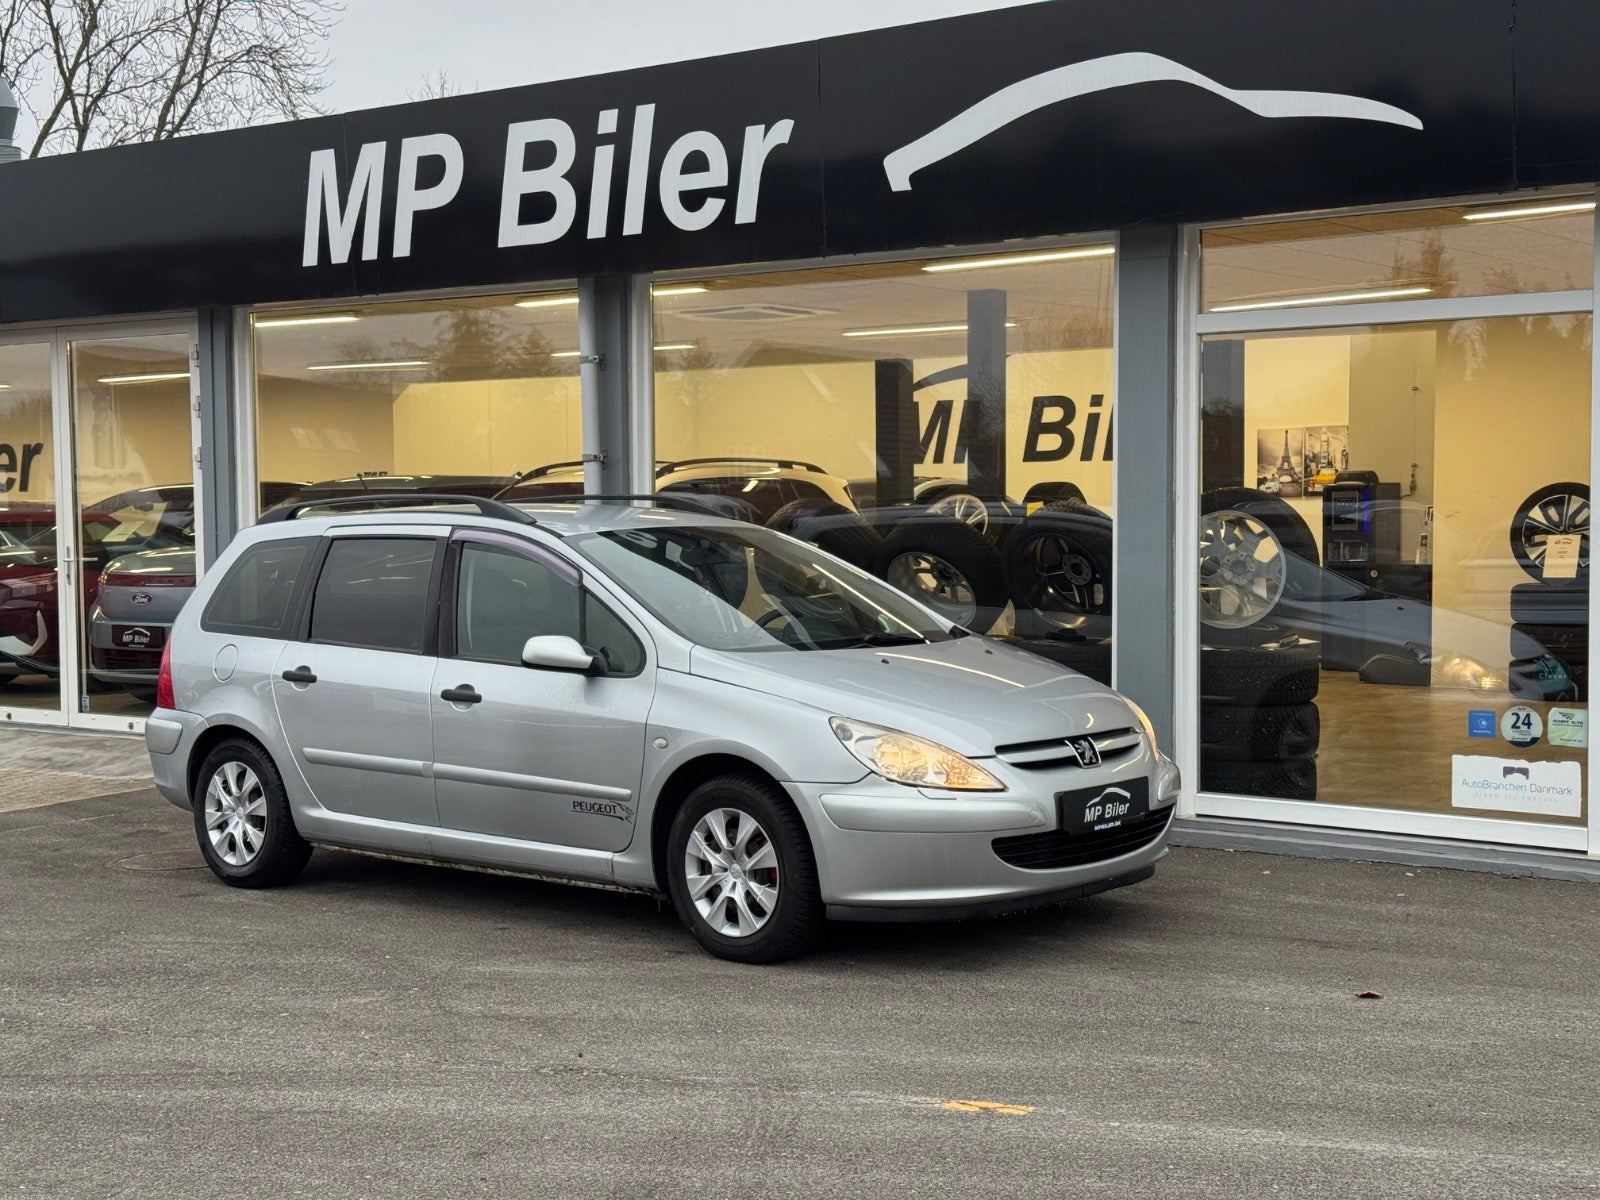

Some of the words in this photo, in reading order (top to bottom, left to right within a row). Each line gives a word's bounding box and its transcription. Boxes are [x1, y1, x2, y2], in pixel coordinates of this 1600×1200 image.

[302, 133, 464, 267] MP
[497, 103, 795, 248] Biler
[122, 634, 133, 643] MP
[134, 635, 150, 644] Biler
[1511, 712, 1532, 729] 24
[1461, 778, 1526, 793] AutoBranchen
[1529, 783, 1573, 796] Danmark
[572, 801, 617, 814] PEUGEOT
[1084, 806, 1102, 823] MP
[1105, 802, 1130, 818] Biler
